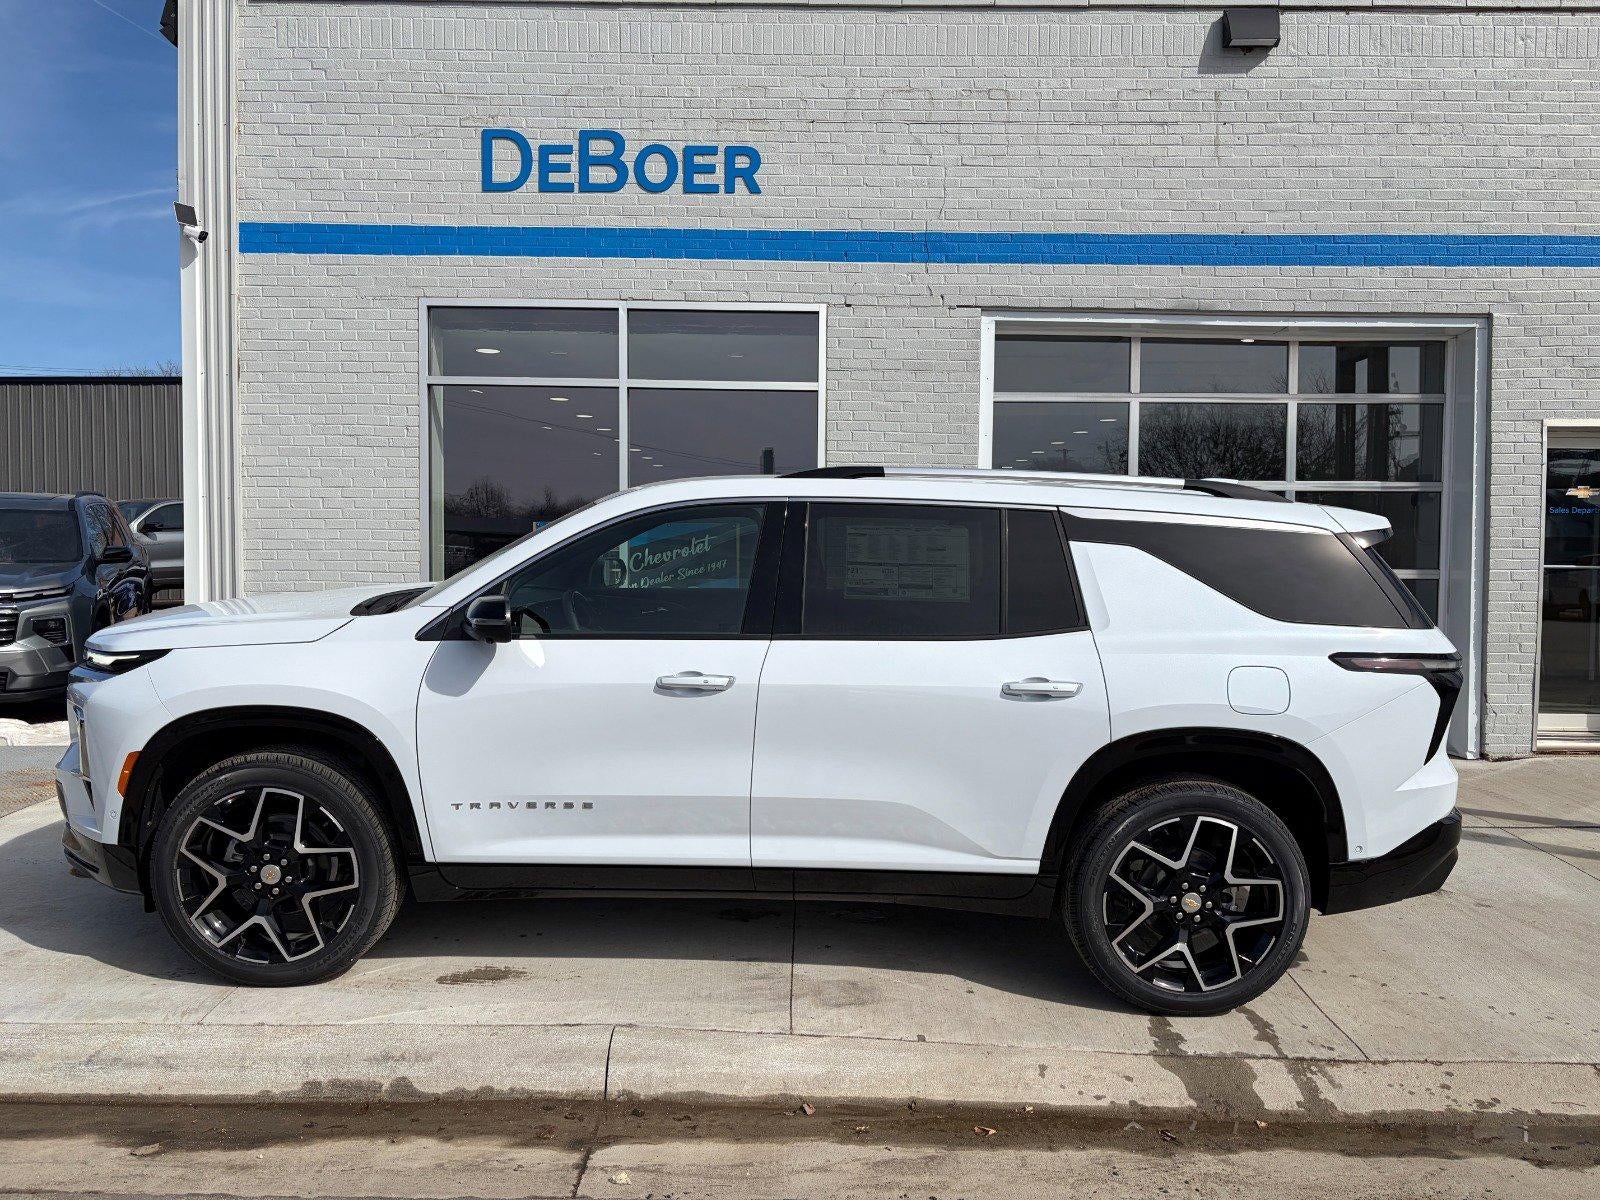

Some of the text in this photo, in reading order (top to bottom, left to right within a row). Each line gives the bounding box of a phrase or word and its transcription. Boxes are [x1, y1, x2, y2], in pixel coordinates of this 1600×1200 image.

[1550, 506, 1600, 515] Sales Depart
[629, 534, 717, 572] Chevrolet
[641, 571, 674, 588] Dealer
[677, 564, 705, 580] Since
[451, 802, 594, 810] TRAVERSE
